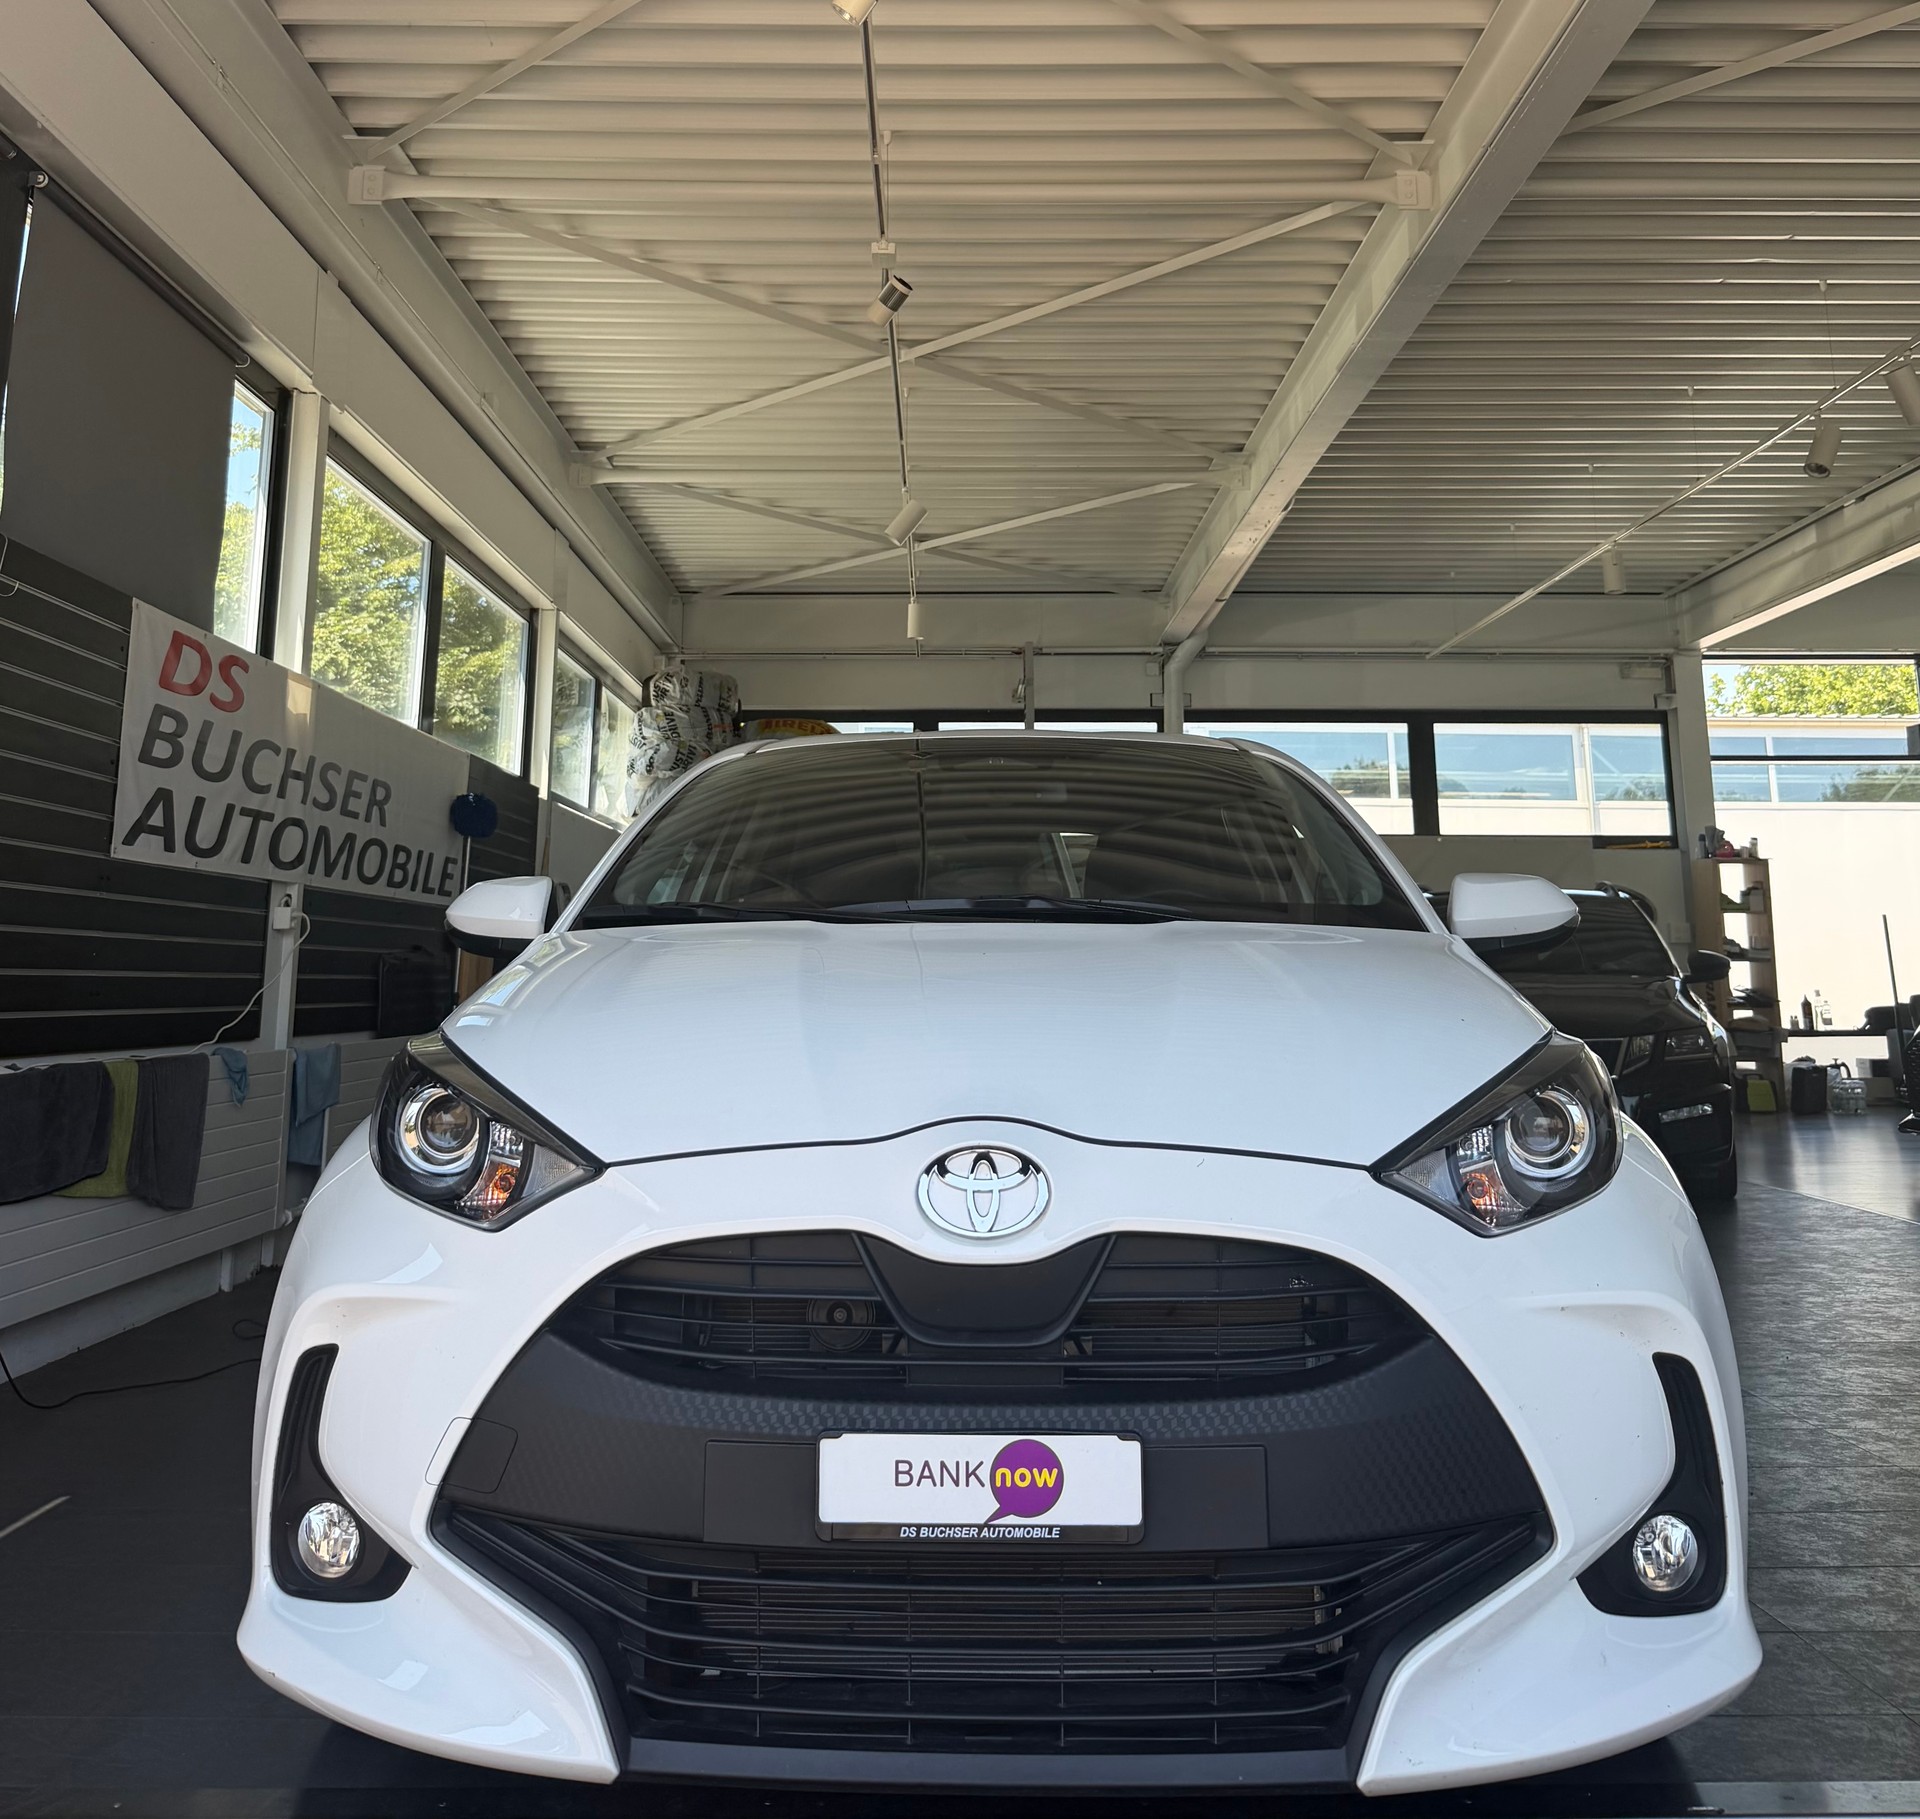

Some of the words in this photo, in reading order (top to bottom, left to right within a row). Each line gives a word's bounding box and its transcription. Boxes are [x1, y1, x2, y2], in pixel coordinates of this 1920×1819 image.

[157, 630, 250, 713] DS
[137, 703, 393, 828] BUCHSER
[121, 787, 459, 898] AUTOMOBILE
[894, 1459, 986, 1488] BANK
[994, 1467, 1059, 1488] now
[900, 1526, 917, 1538] DS
[919, 1526, 979, 1539] BUCHSER
[980, 1526, 1061, 1539] AUTOMOBILE
